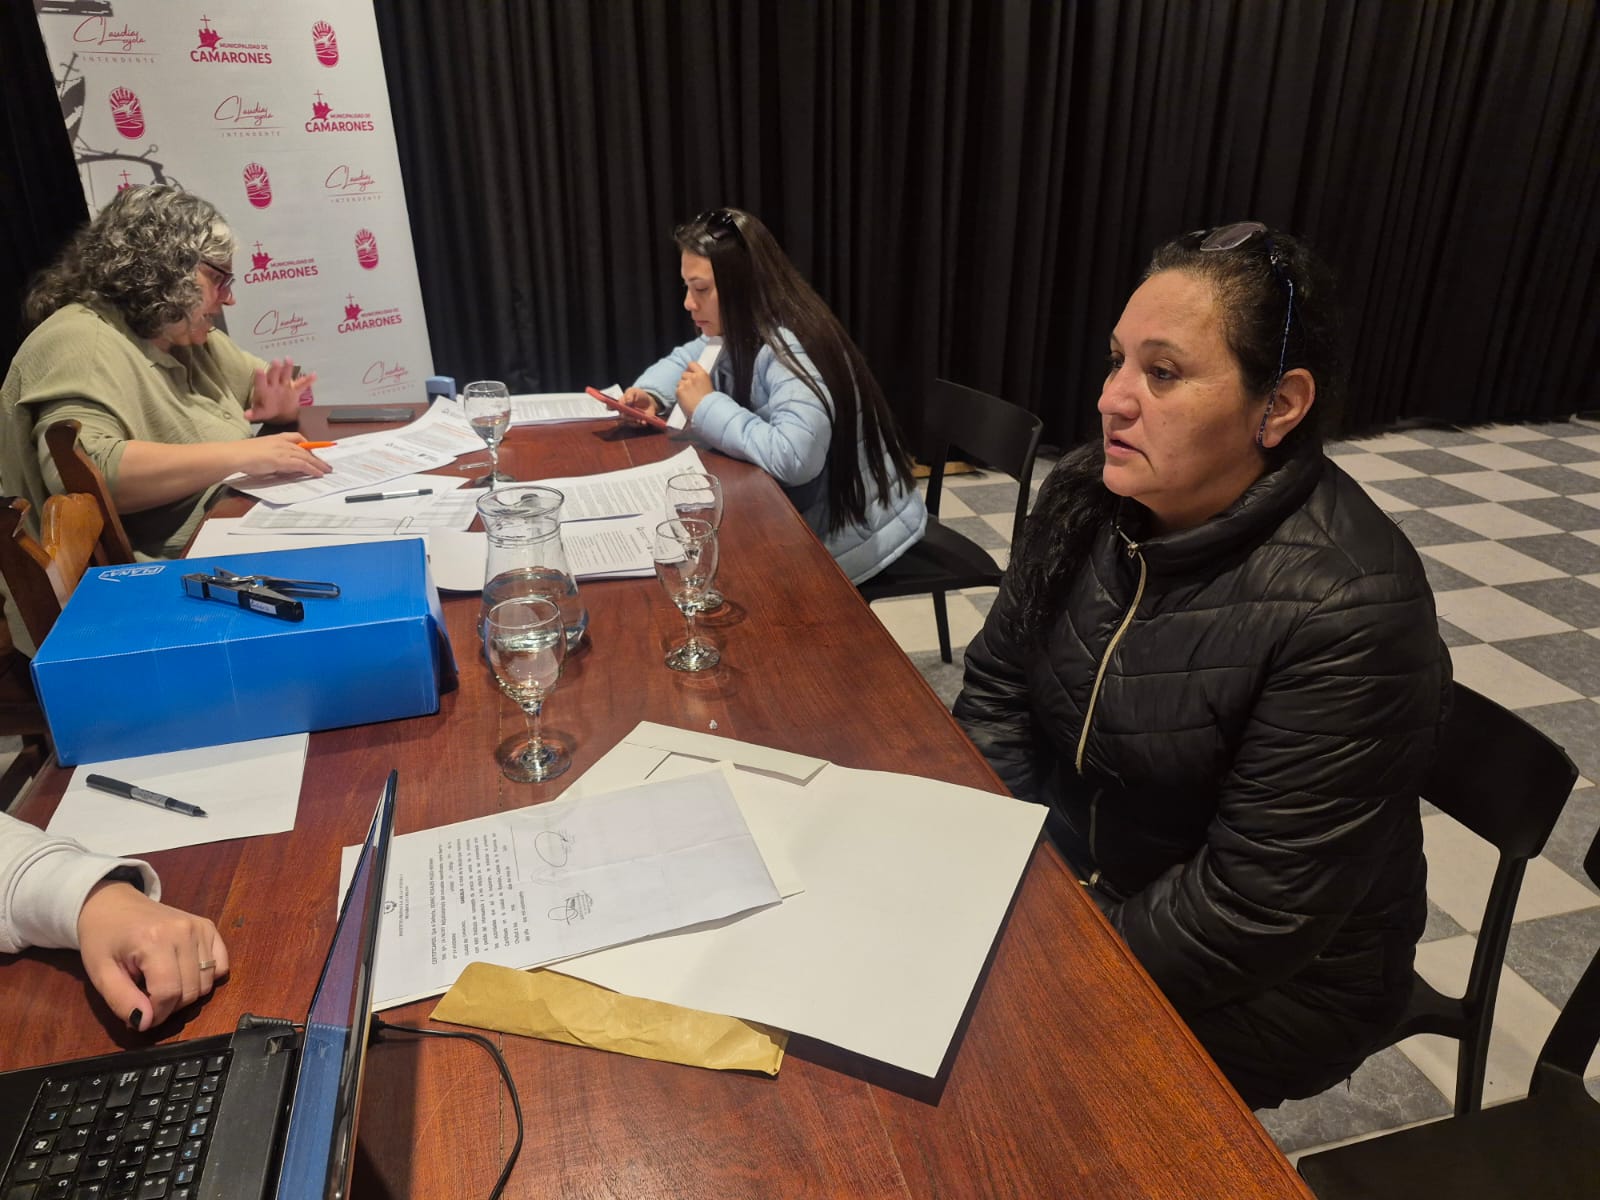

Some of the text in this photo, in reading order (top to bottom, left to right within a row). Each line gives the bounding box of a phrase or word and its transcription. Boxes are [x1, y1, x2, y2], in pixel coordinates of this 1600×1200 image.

[82, 55, 155, 64] INTENDENTE
[190, 50, 272, 65] CAMARONES
[305, 120, 375, 133] CAMARONES
[244, 265, 319, 284] CAMARONES
[337, 314, 402, 335] CAMARONES
